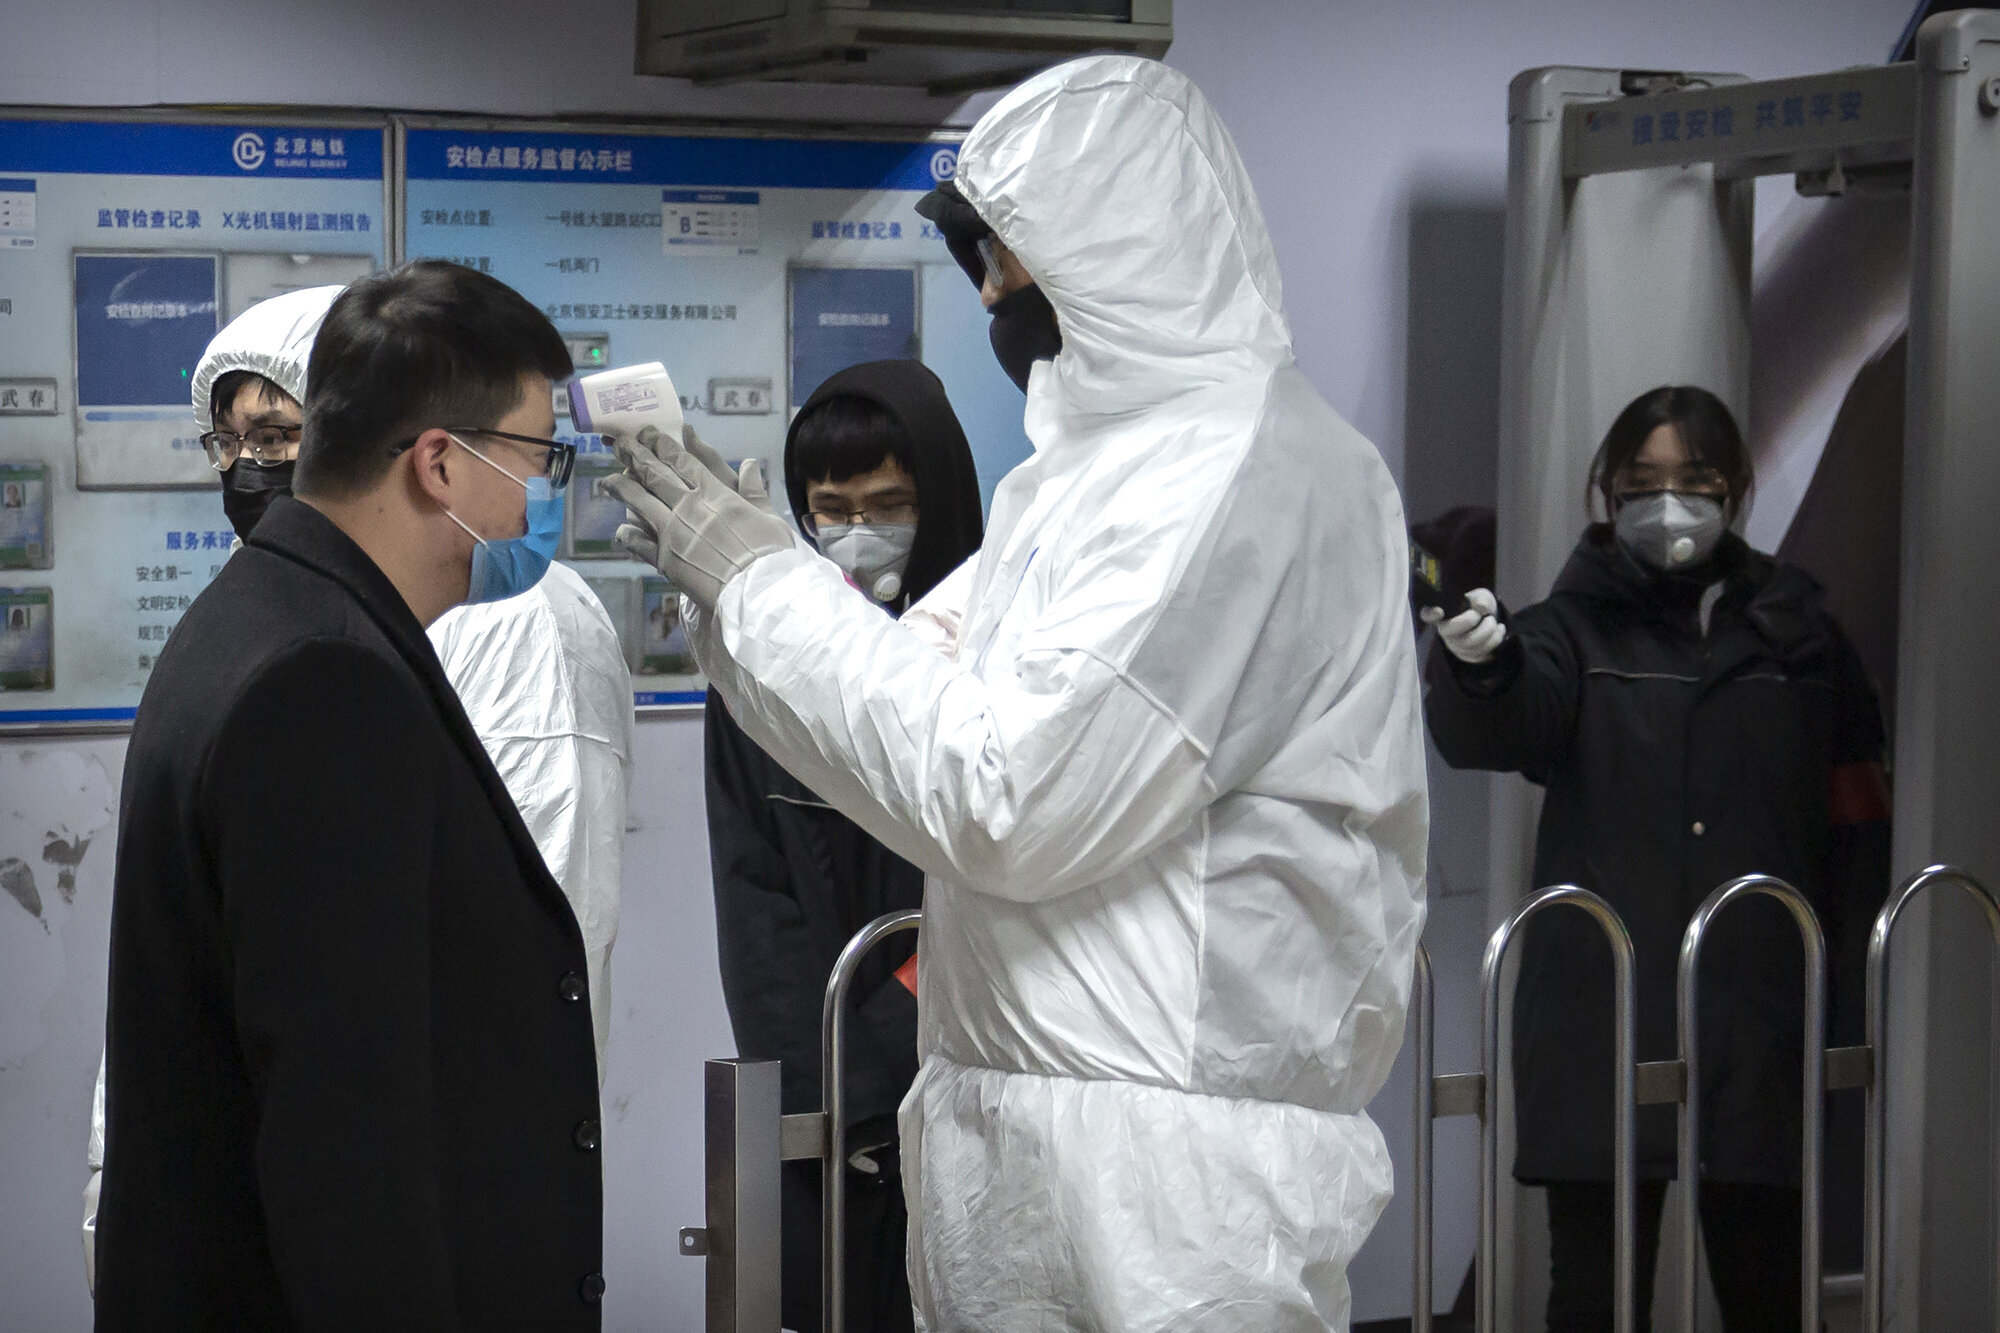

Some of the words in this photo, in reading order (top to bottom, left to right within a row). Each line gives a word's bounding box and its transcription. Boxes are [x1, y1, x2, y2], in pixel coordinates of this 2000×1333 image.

[274, 137, 345, 156] 北京地铁
[447, 145, 632, 171] 安检点服务监督公示栏
[97, 209, 201, 229] 监管检查记录
[222, 211, 371, 231] X光机辐射监测报告
[812, 220, 902, 239] 监管检查记录
[166, 530, 236, 551] 服务承诺
[136, 565, 193, 582] 安全第一
